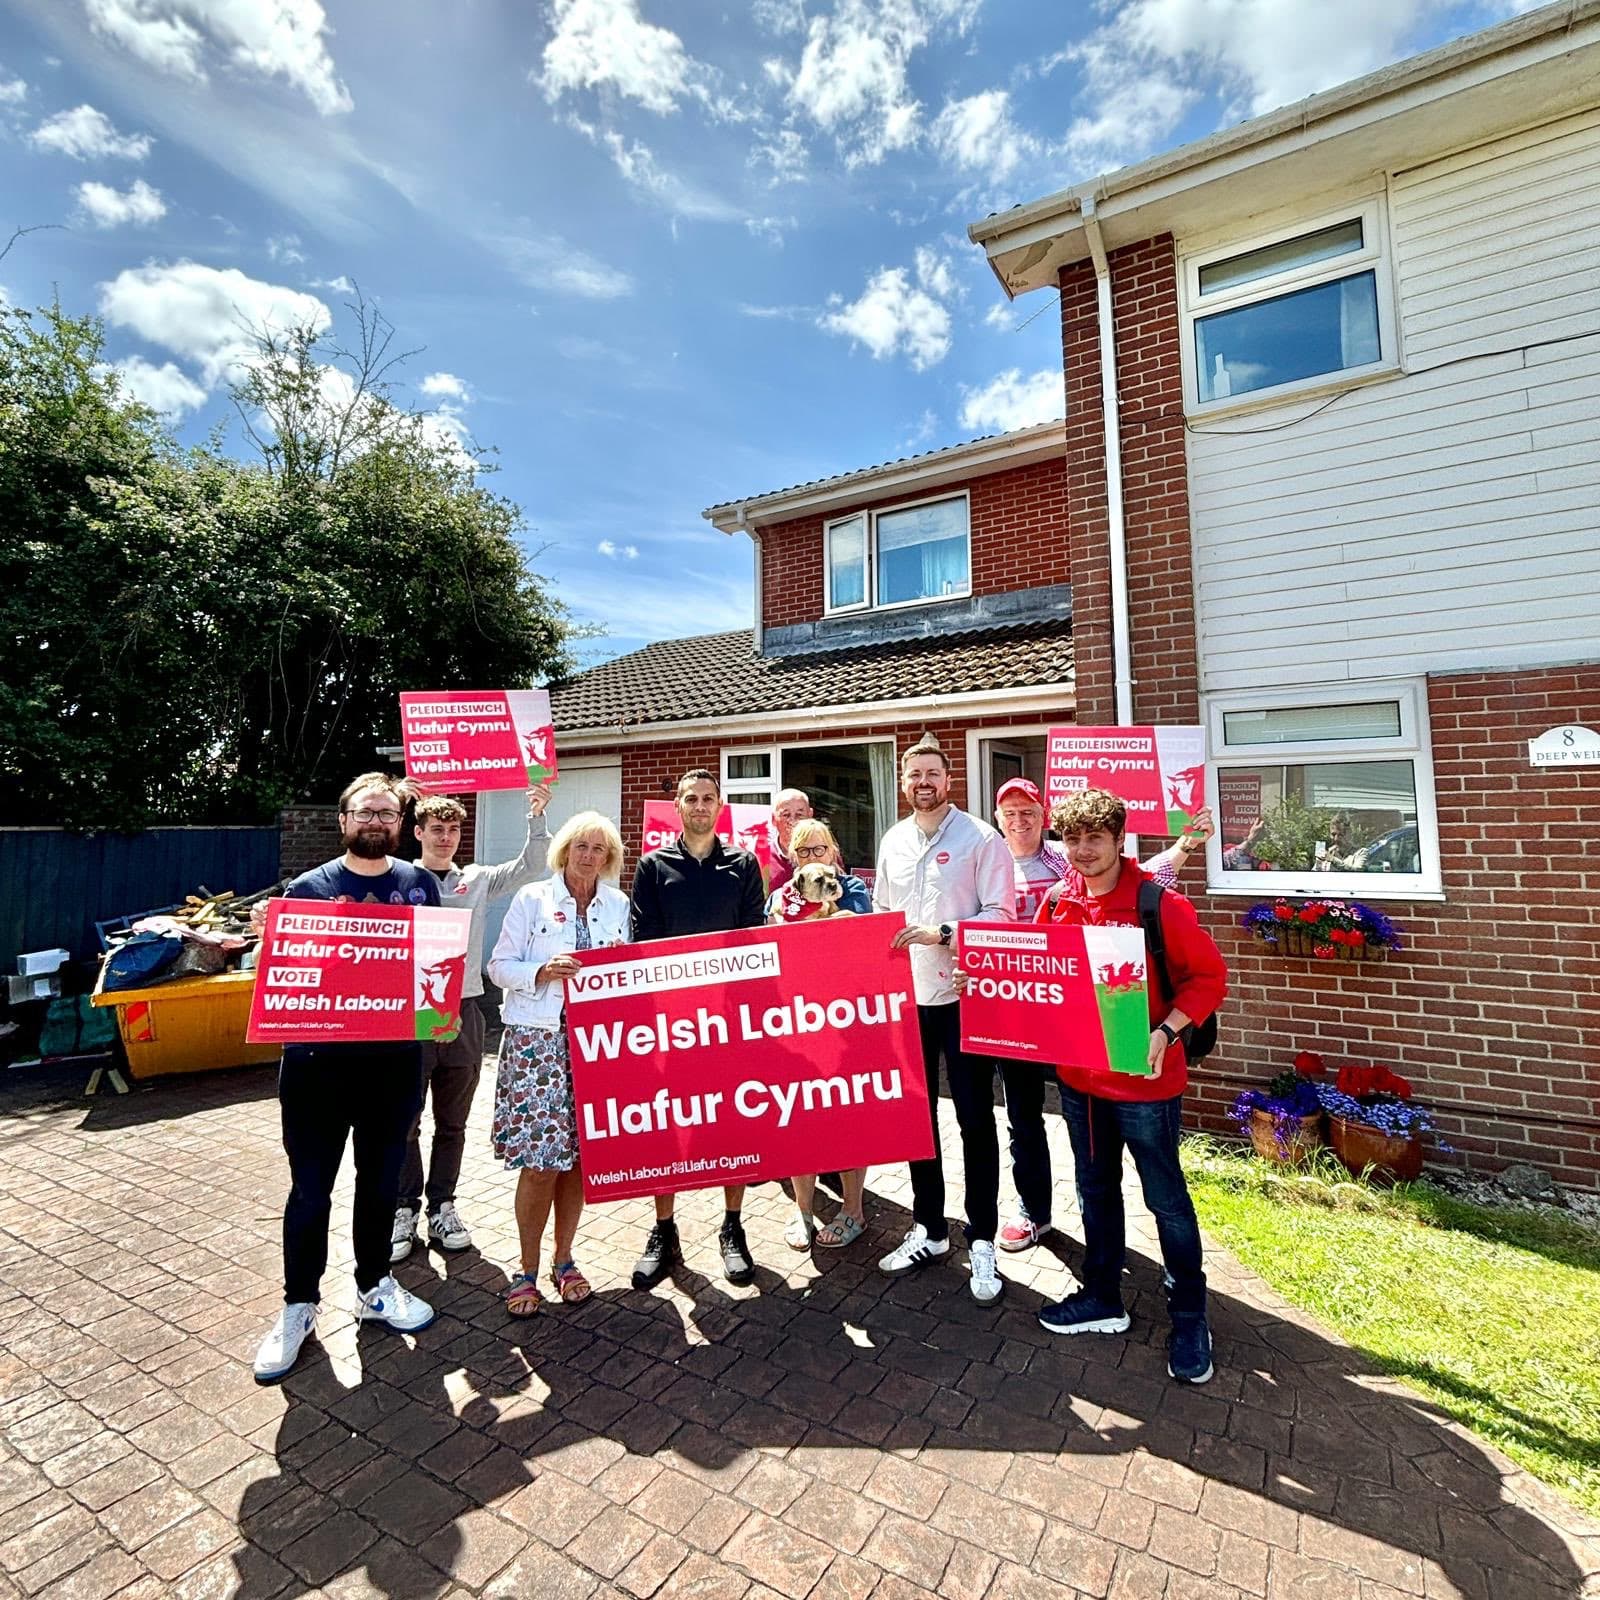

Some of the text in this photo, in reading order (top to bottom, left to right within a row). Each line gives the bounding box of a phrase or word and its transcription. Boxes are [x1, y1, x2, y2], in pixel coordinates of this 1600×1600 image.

[410, 704, 502, 714] PLEIDLEISIWCH
[408, 721, 510, 736] Llafur Cymru
[1054, 740, 1148, 750] PLEIDLEISIWCH
[1563, 729, 1574, 746] 8
[412, 744, 447, 753] VOTE
[1536, 752, 1568, 760] DEEP
[410, 758, 518, 774] Welsh Labour
[1050, 756, 1154, 774] Llafur Cymru
[1053, 779, 1084, 788] VOTE
[281, 918, 405, 935] PLEIDLEISIWCH
[965, 934, 1046, 945] VOTE PLEIDLEISIWCH
[272, 940, 336, 958] Llafur
[338, 944, 408, 963] Cymru
[572, 951, 775, 994] VOTE PLEIDLEISIWCH
[965, 952, 1079, 976] CATHERINE
[272, 970, 317, 983] VOTE
[966, 976, 1064, 1004] FOOKES
[264, 994, 407, 1011] Welsh Labour
[574, 991, 908, 1062] Welsh Labour
[583, 1069, 903, 1140] Llafur Cymru
[588, 1153, 760, 1186] Welsh Labour Llafur Cymru
